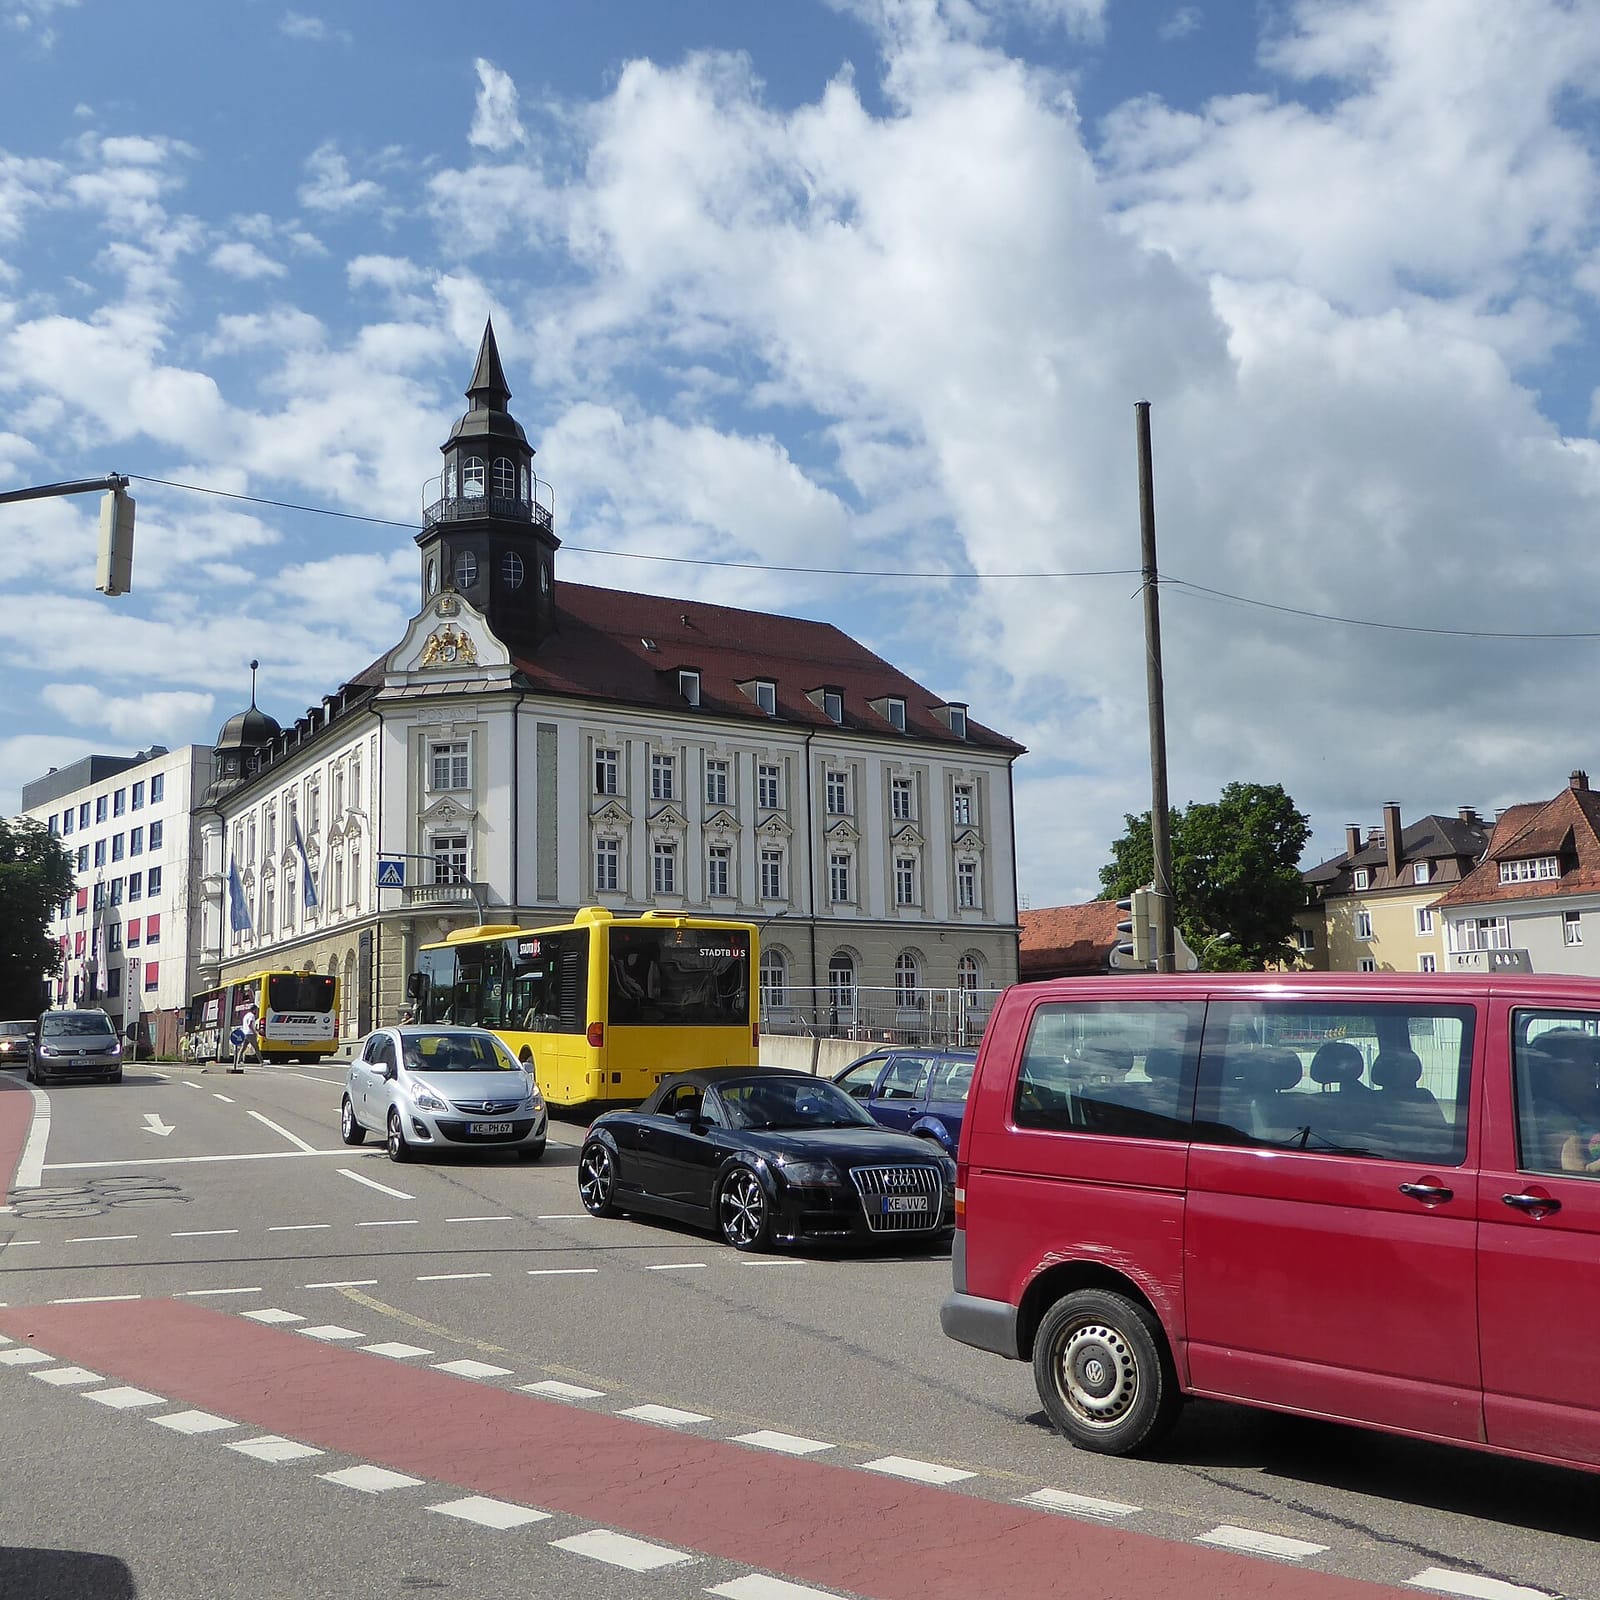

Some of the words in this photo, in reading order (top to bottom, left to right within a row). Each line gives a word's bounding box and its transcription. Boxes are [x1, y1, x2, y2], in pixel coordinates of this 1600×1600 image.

[699, 948, 746, 957] STADTBUS
[473, 1124, 484, 1132] KE
[888, 1198, 901, 1210] KE
